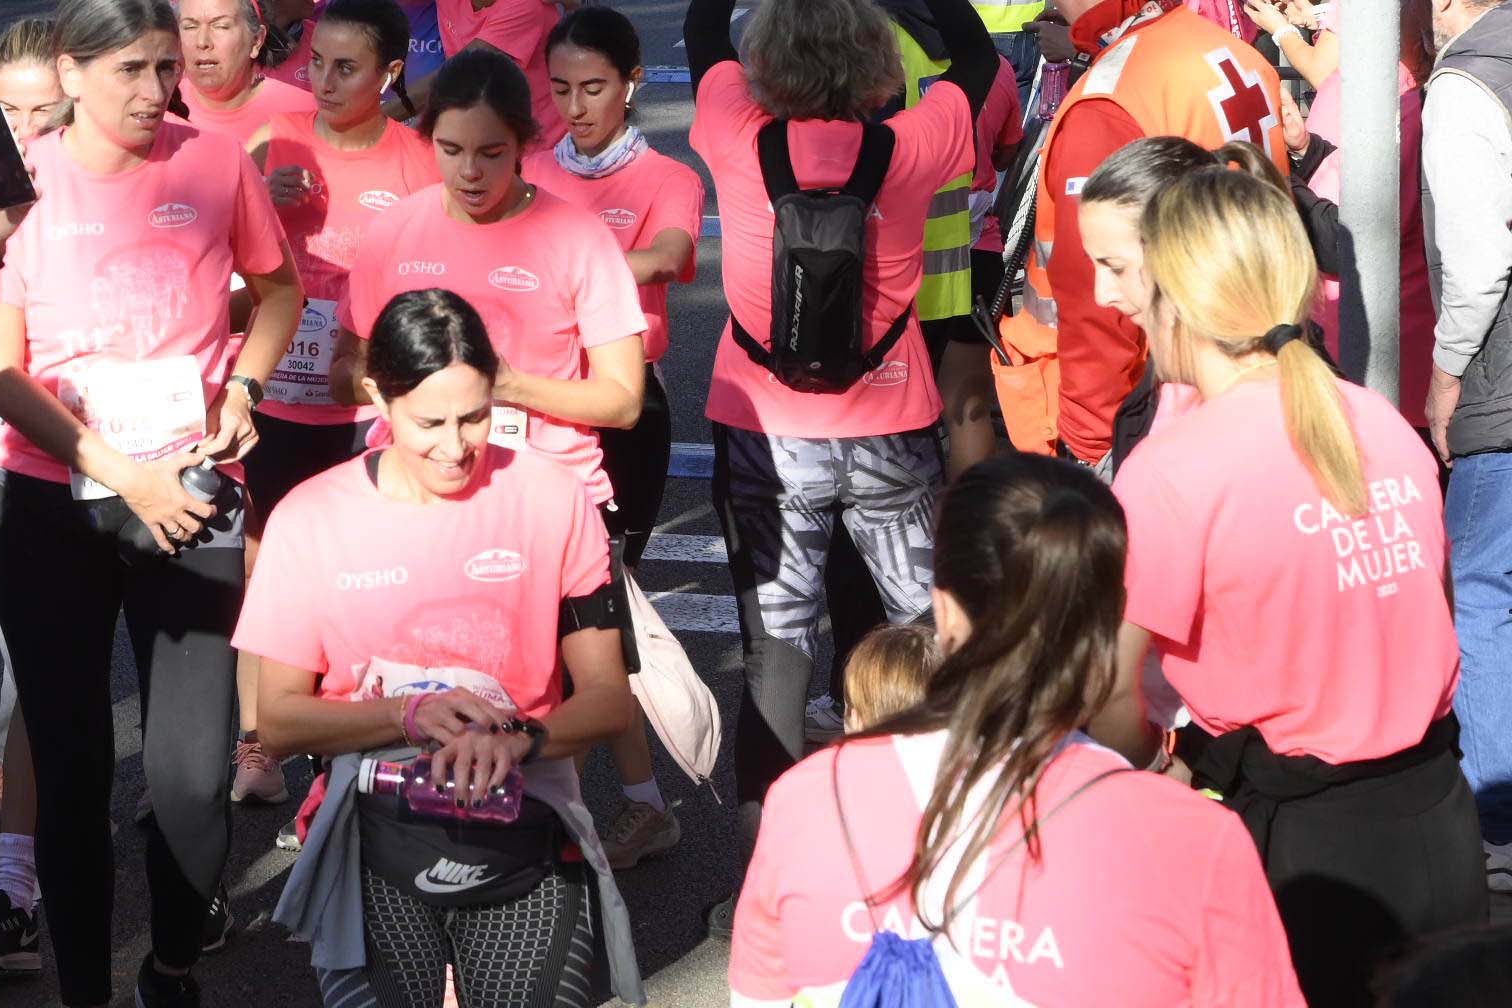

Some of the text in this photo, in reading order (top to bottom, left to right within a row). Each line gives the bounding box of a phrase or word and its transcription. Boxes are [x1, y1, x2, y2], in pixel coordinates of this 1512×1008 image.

[288, 359, 315, 372] 30042
[1294, 474, 1423, 535] CAERA
[1331, 520, 1373, 558] DE
[1375, 510, 1414, 545] LA
[337, 566, 409, 592] OYSHO
[1337, 541, 1425, 593] MUJER
[428, 857, 489, 885] NIKE
[841, 900, 1064, 969] CAERA
